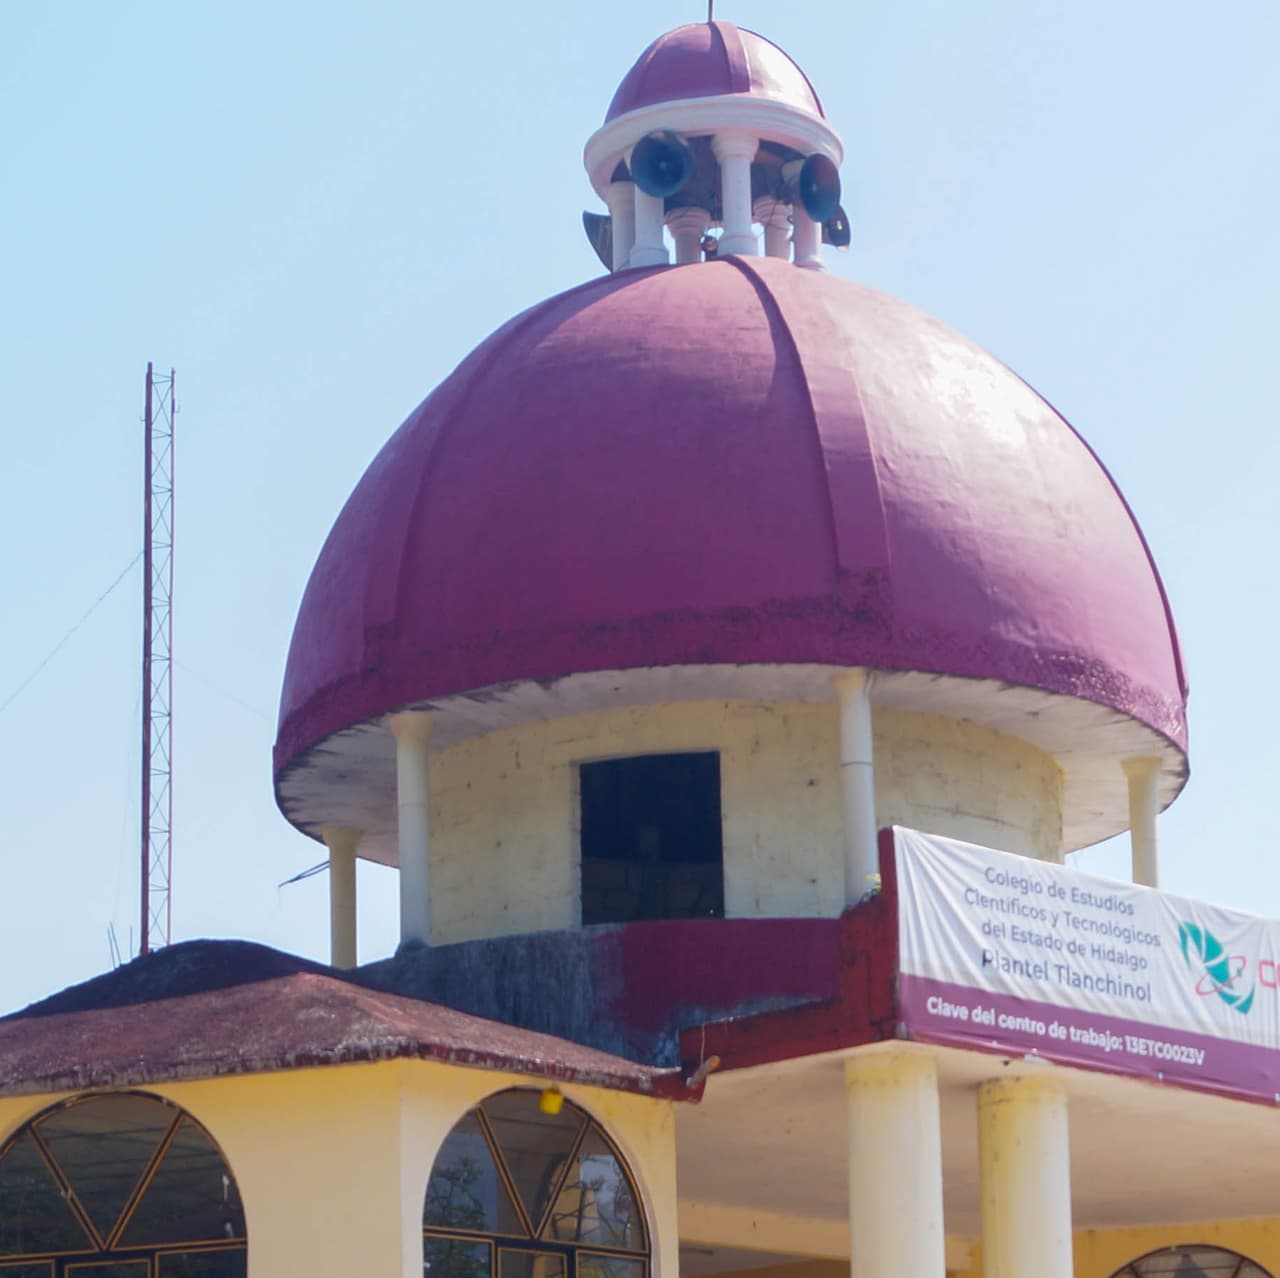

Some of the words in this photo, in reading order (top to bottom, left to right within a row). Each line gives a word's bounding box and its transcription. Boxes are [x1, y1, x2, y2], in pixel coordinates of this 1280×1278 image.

[985, 867, 1043, 895] Colegio
[1048, 881, 1066, 900] de
[1072, 888, 1135, 916] Estudios
[982, 919, 1006, 938] del
[1011, 926, 1063, 951] Estado
[1067, 939, 1088, 957] de
[1091, 943, 1148, 972] Hidalgo
[1051, 911, 1060, 928] y
[982, 950, 1049, 981] Plantel
[1054, 964, 1152, 1004] Tlanchinol
[926, 996, 969, 1020] Clave
[971, 1003, 996, 1026] del
[998, 1012, 1046, 1037] centro
[1048, 1020, 1068, 1040] de
[1070, 1027, 1123, 1051] trabajo:
